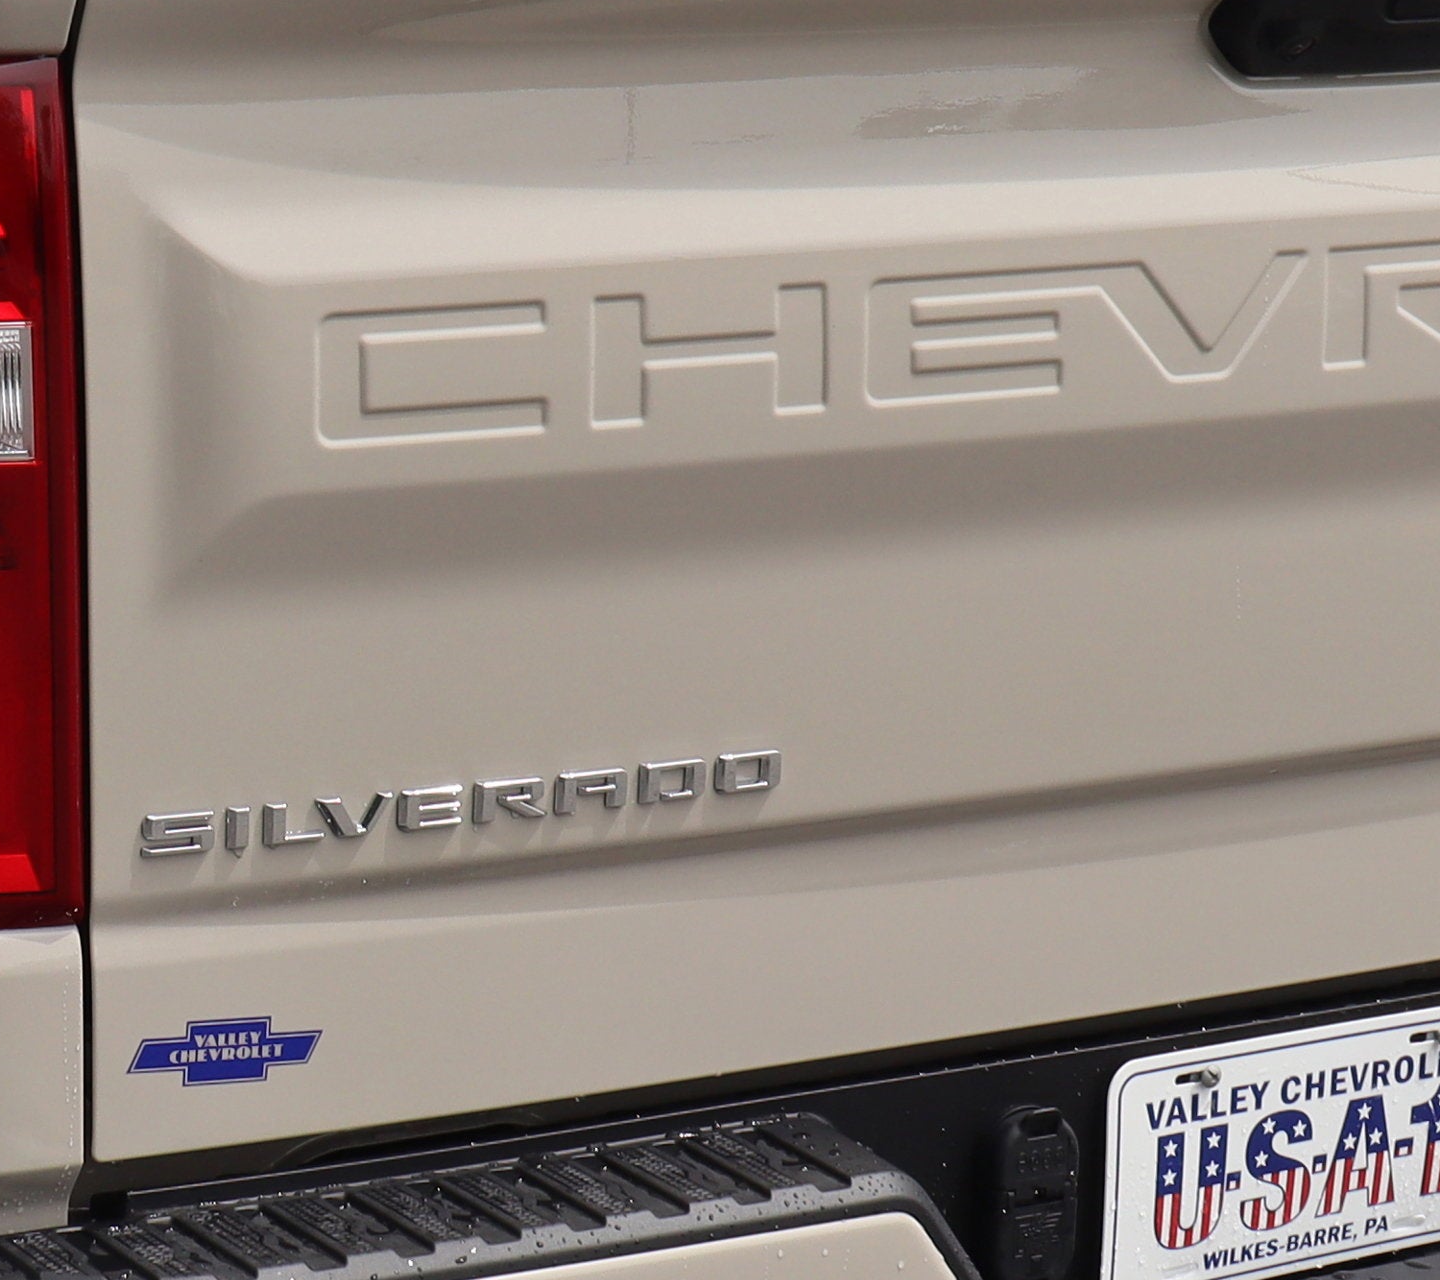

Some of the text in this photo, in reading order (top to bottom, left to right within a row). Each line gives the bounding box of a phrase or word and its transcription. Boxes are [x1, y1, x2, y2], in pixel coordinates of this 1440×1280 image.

[140, 749, 782, 857] SILVERADO
[169, 1043, 284, 1064] CHEVROLET
[194, 1031, 262, 1048] VALLEY
[1146, 1080, 1270, 1130] VALLEY
[1203, 1216, 1388, 1271] WILKES-BARRE, PA
